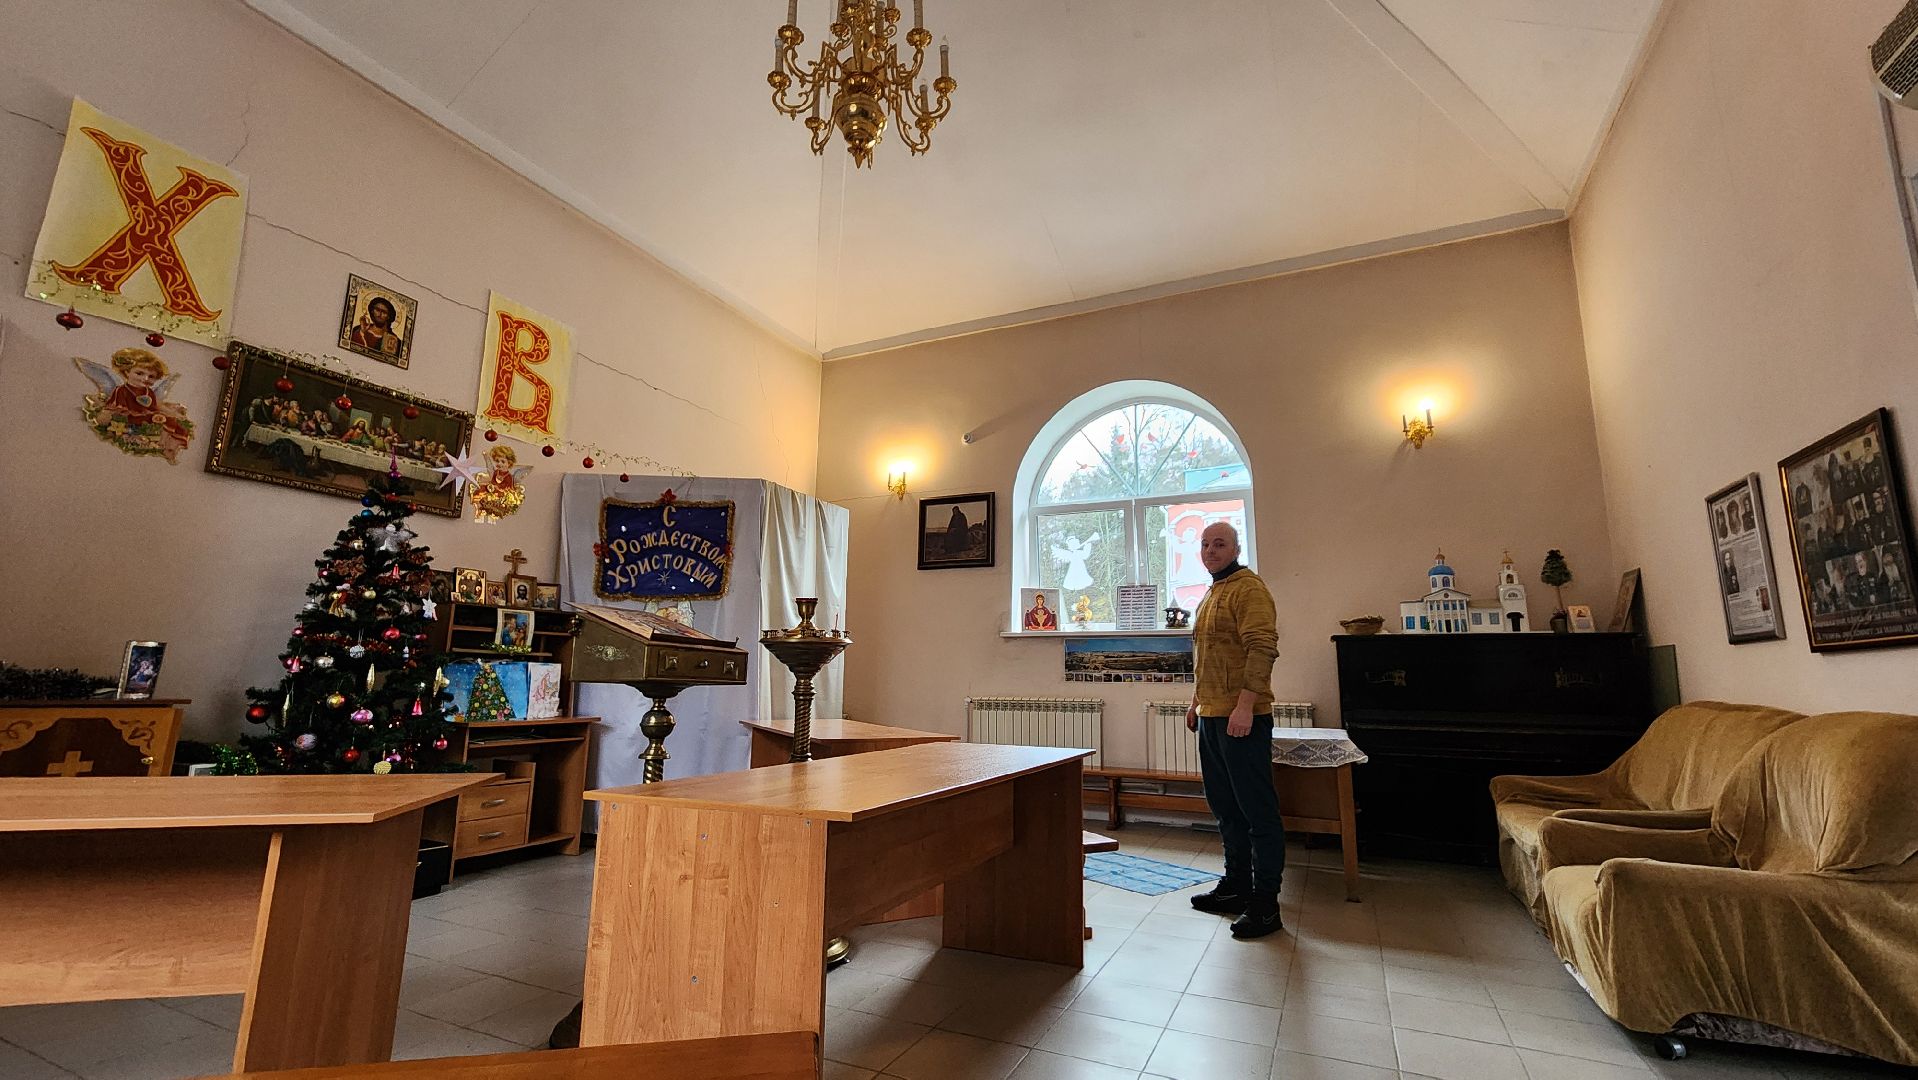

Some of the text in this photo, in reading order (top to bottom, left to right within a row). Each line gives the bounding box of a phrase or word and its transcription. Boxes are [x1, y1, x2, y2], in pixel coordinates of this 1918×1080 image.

[52, 126, 240, 321] Х
[486, 310, 555, 434] В
[662, 505, 677, 527] С
